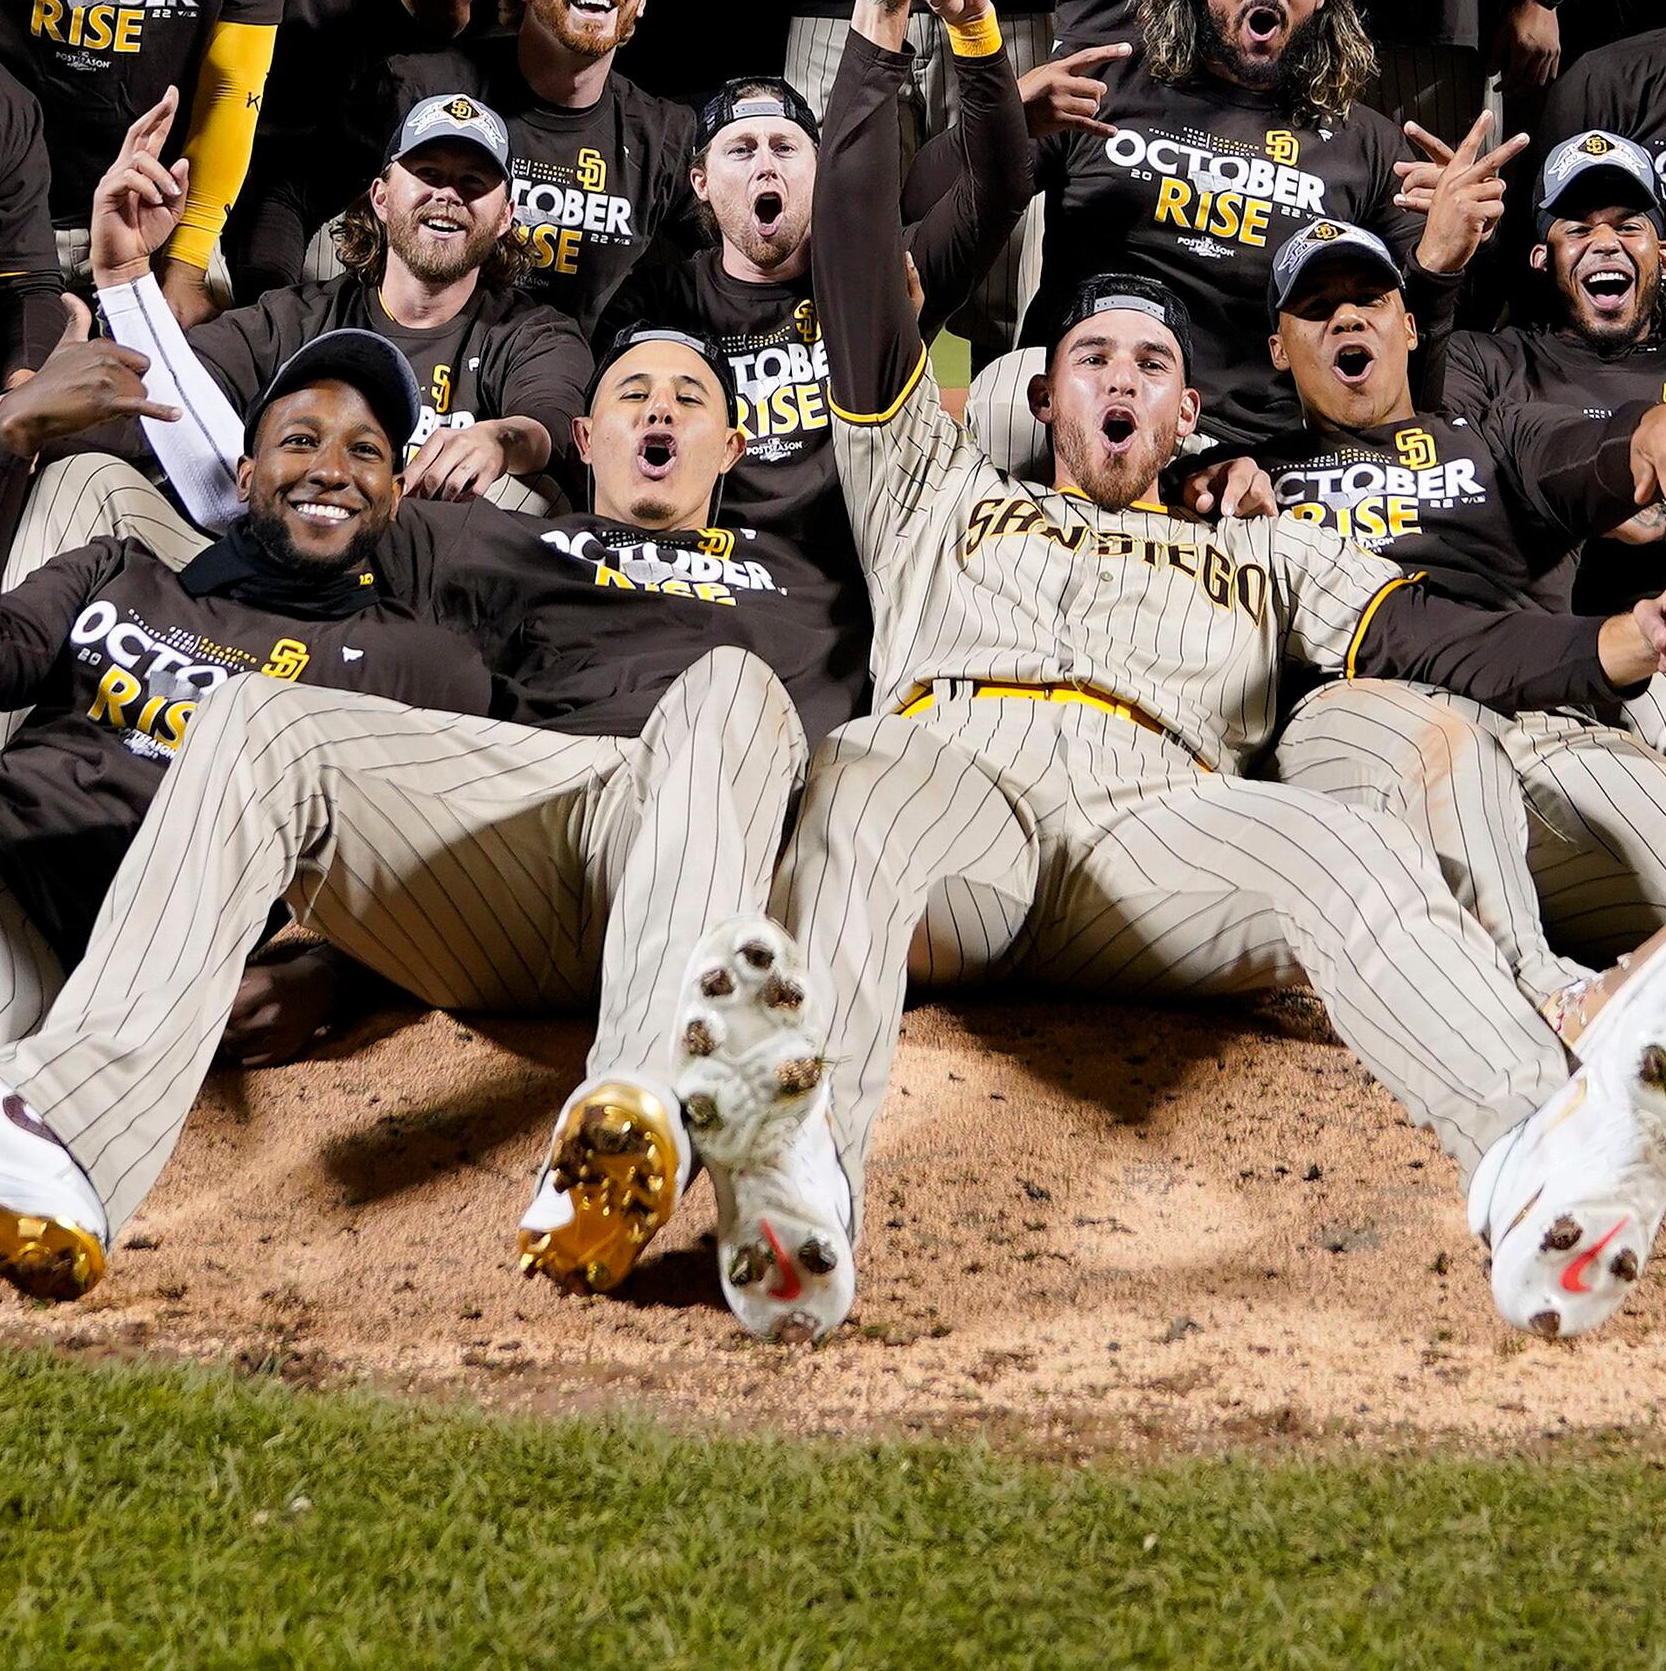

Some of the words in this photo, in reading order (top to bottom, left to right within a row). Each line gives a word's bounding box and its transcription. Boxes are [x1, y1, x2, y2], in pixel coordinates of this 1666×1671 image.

[151, 8, 172, 19] 22
[1265, 130, 1300, 166] SD
[576, 148, 608, 192] SD
[1104, 128, 1327, 215] OCTOBER
[1130, 168, 1153, 181] 20
[1154, 177, 1275, 247] RISE
[1281, 205, 1302, 217] 22
[590, 233, 610, 244] 22
[737, 382, 829, 442] RISE
[1395, 428, 1438, 468] SD
[1293, 496, 1424, 541] RISE
[1429, 497, 1453, 509] 22
[964, 495, 1085, 561] SAN
[1093, 530, 1268, 629] DIEGO
[77, 648, 103, 666] 20
[260, 637, 312, 682] SD
